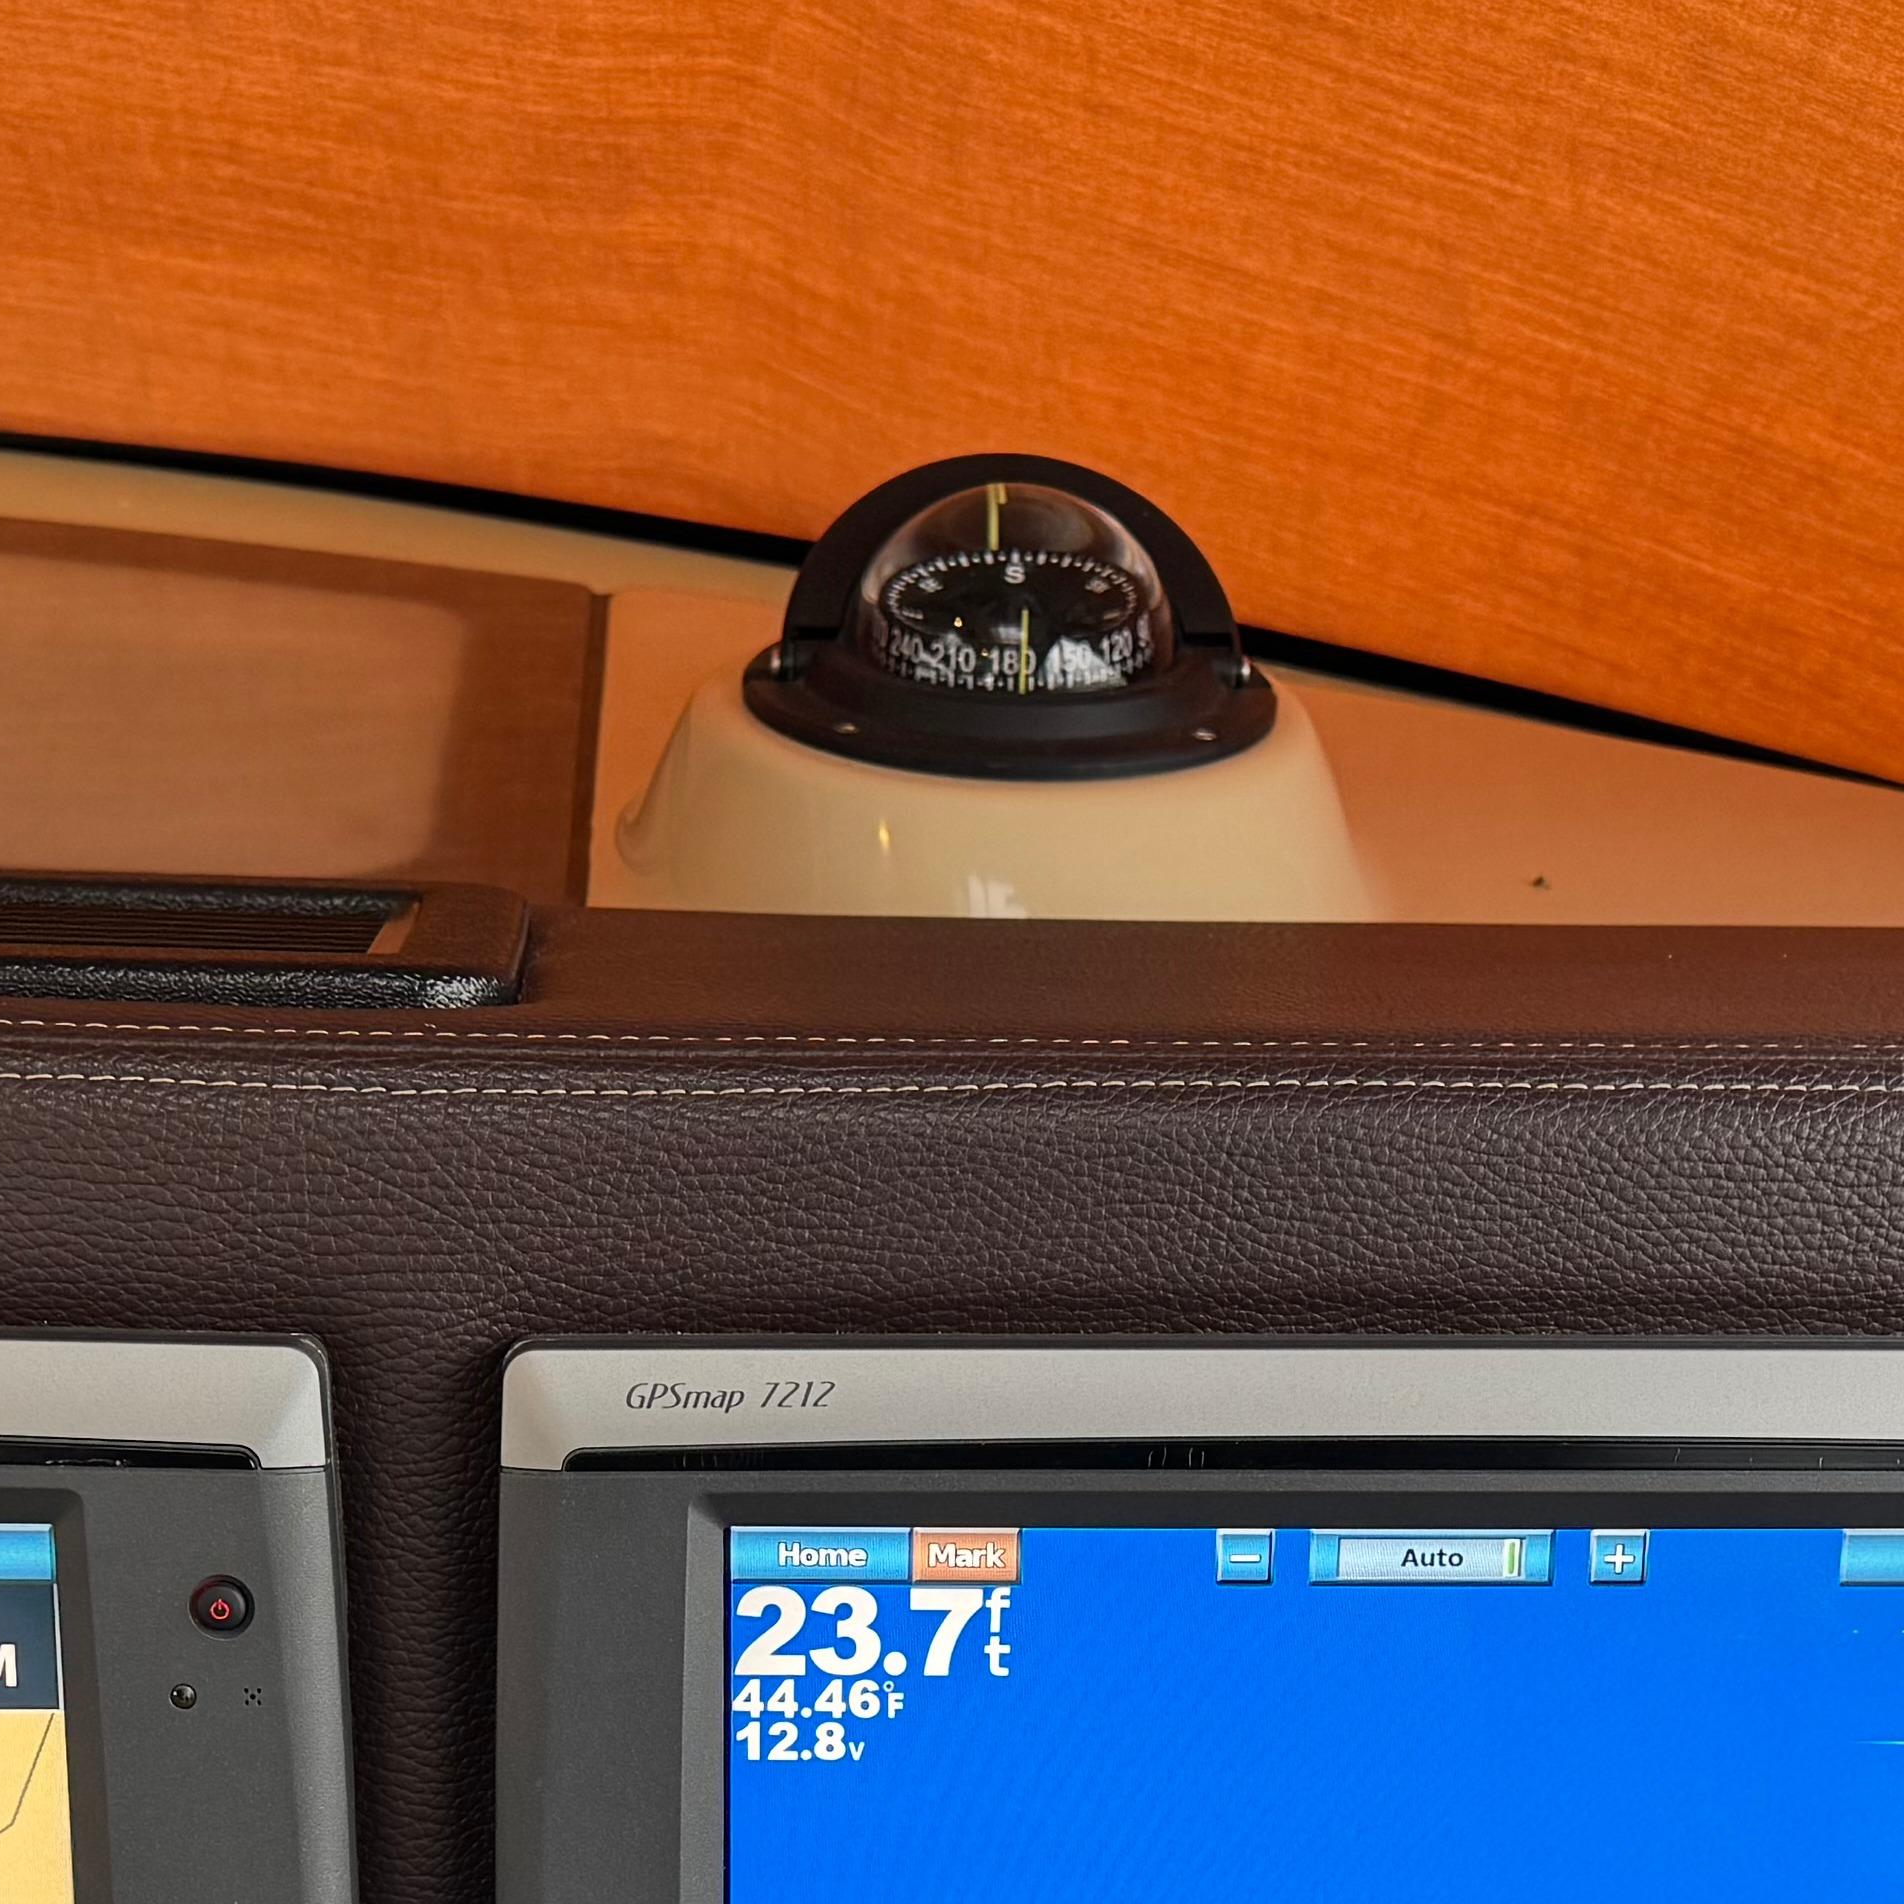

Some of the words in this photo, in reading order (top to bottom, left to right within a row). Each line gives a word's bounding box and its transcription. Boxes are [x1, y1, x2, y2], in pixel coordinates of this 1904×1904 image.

[1004, 563, 1025, 585] S
[932, 645, 977, 673] 210
[990, 648, 1037, 676] 180
[1053, 647, 1091, 672] 150
[1101, 626, 1134, 661] 120
[626, 1383, 745, 1414] GPSmap
[760, 1381, 836, 1408] 7212
[777, 1542, 868, 1568] Home
[927, 1543, 1006, 1569] Mark
[1400, 1548, 1464, 1569] Auto
